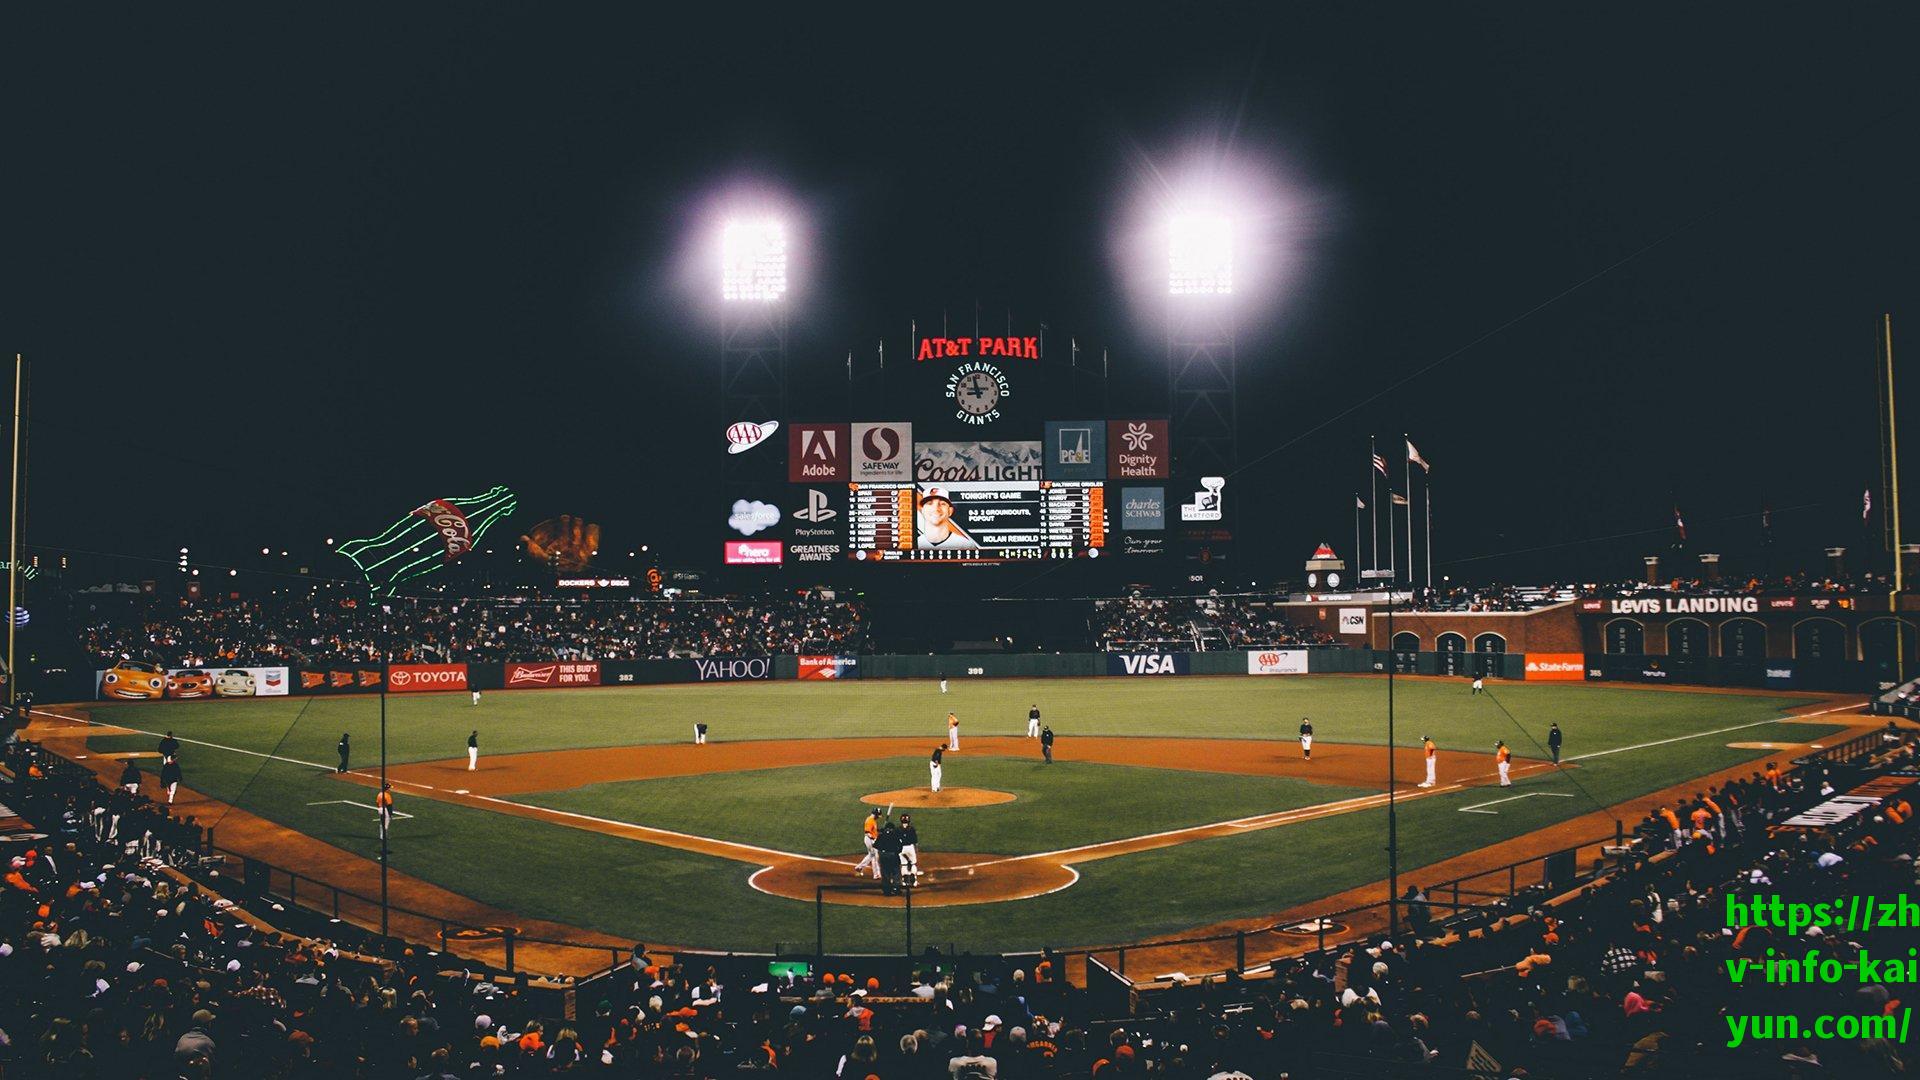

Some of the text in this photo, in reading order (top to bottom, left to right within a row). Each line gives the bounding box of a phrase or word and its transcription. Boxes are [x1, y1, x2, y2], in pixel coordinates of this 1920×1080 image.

[918, 336, 1039, 360] AT&T PARK
[945, 361, 1010, 398] SAN FRANCISCO
[956, 409, 1000, 425] GIANTS
[729, 424, 762, 443] AAA
[1061, 449, 1089, 462] PG&E
[1119, 454, 1157, 466] Dignity
[802, 464, 836, 476] Adobe
[862, 462, 900, 470] SAFEWAY
[914, 458, 1043, 481] Coors LIGHT
[1121, 466, 1156, 476] Health
[961, 492, 998, 500] TONIGHT'S
[1126, 499, 1160, 510] charles
[795, 528, 835, 537] PlayStation
[983, 535, 1007, 543] NOLAN
[790, 545, 840, 553] GREATNESS
[799, 553, 832, 561] AWAITS
[558, 579, 629, 587] DOCKERS DECK
[1666, 597, 1759, 613] LANDING
[1350, 616, 1364, 625] CSN
[800, 658, 818, 666] Bank
[1119, 654, 1176, 674] VISA
[1259, 653, 1280, 666] AAA
[559, 664, 597, 673] THIS BUD'S
[695, 658, 770, 681] YAHOO!
[412, 671, 467, 683] TOYOTA
[515, 670, 551, 679] Budweiser
[559, 674, 590, 682] FOR YOU.
